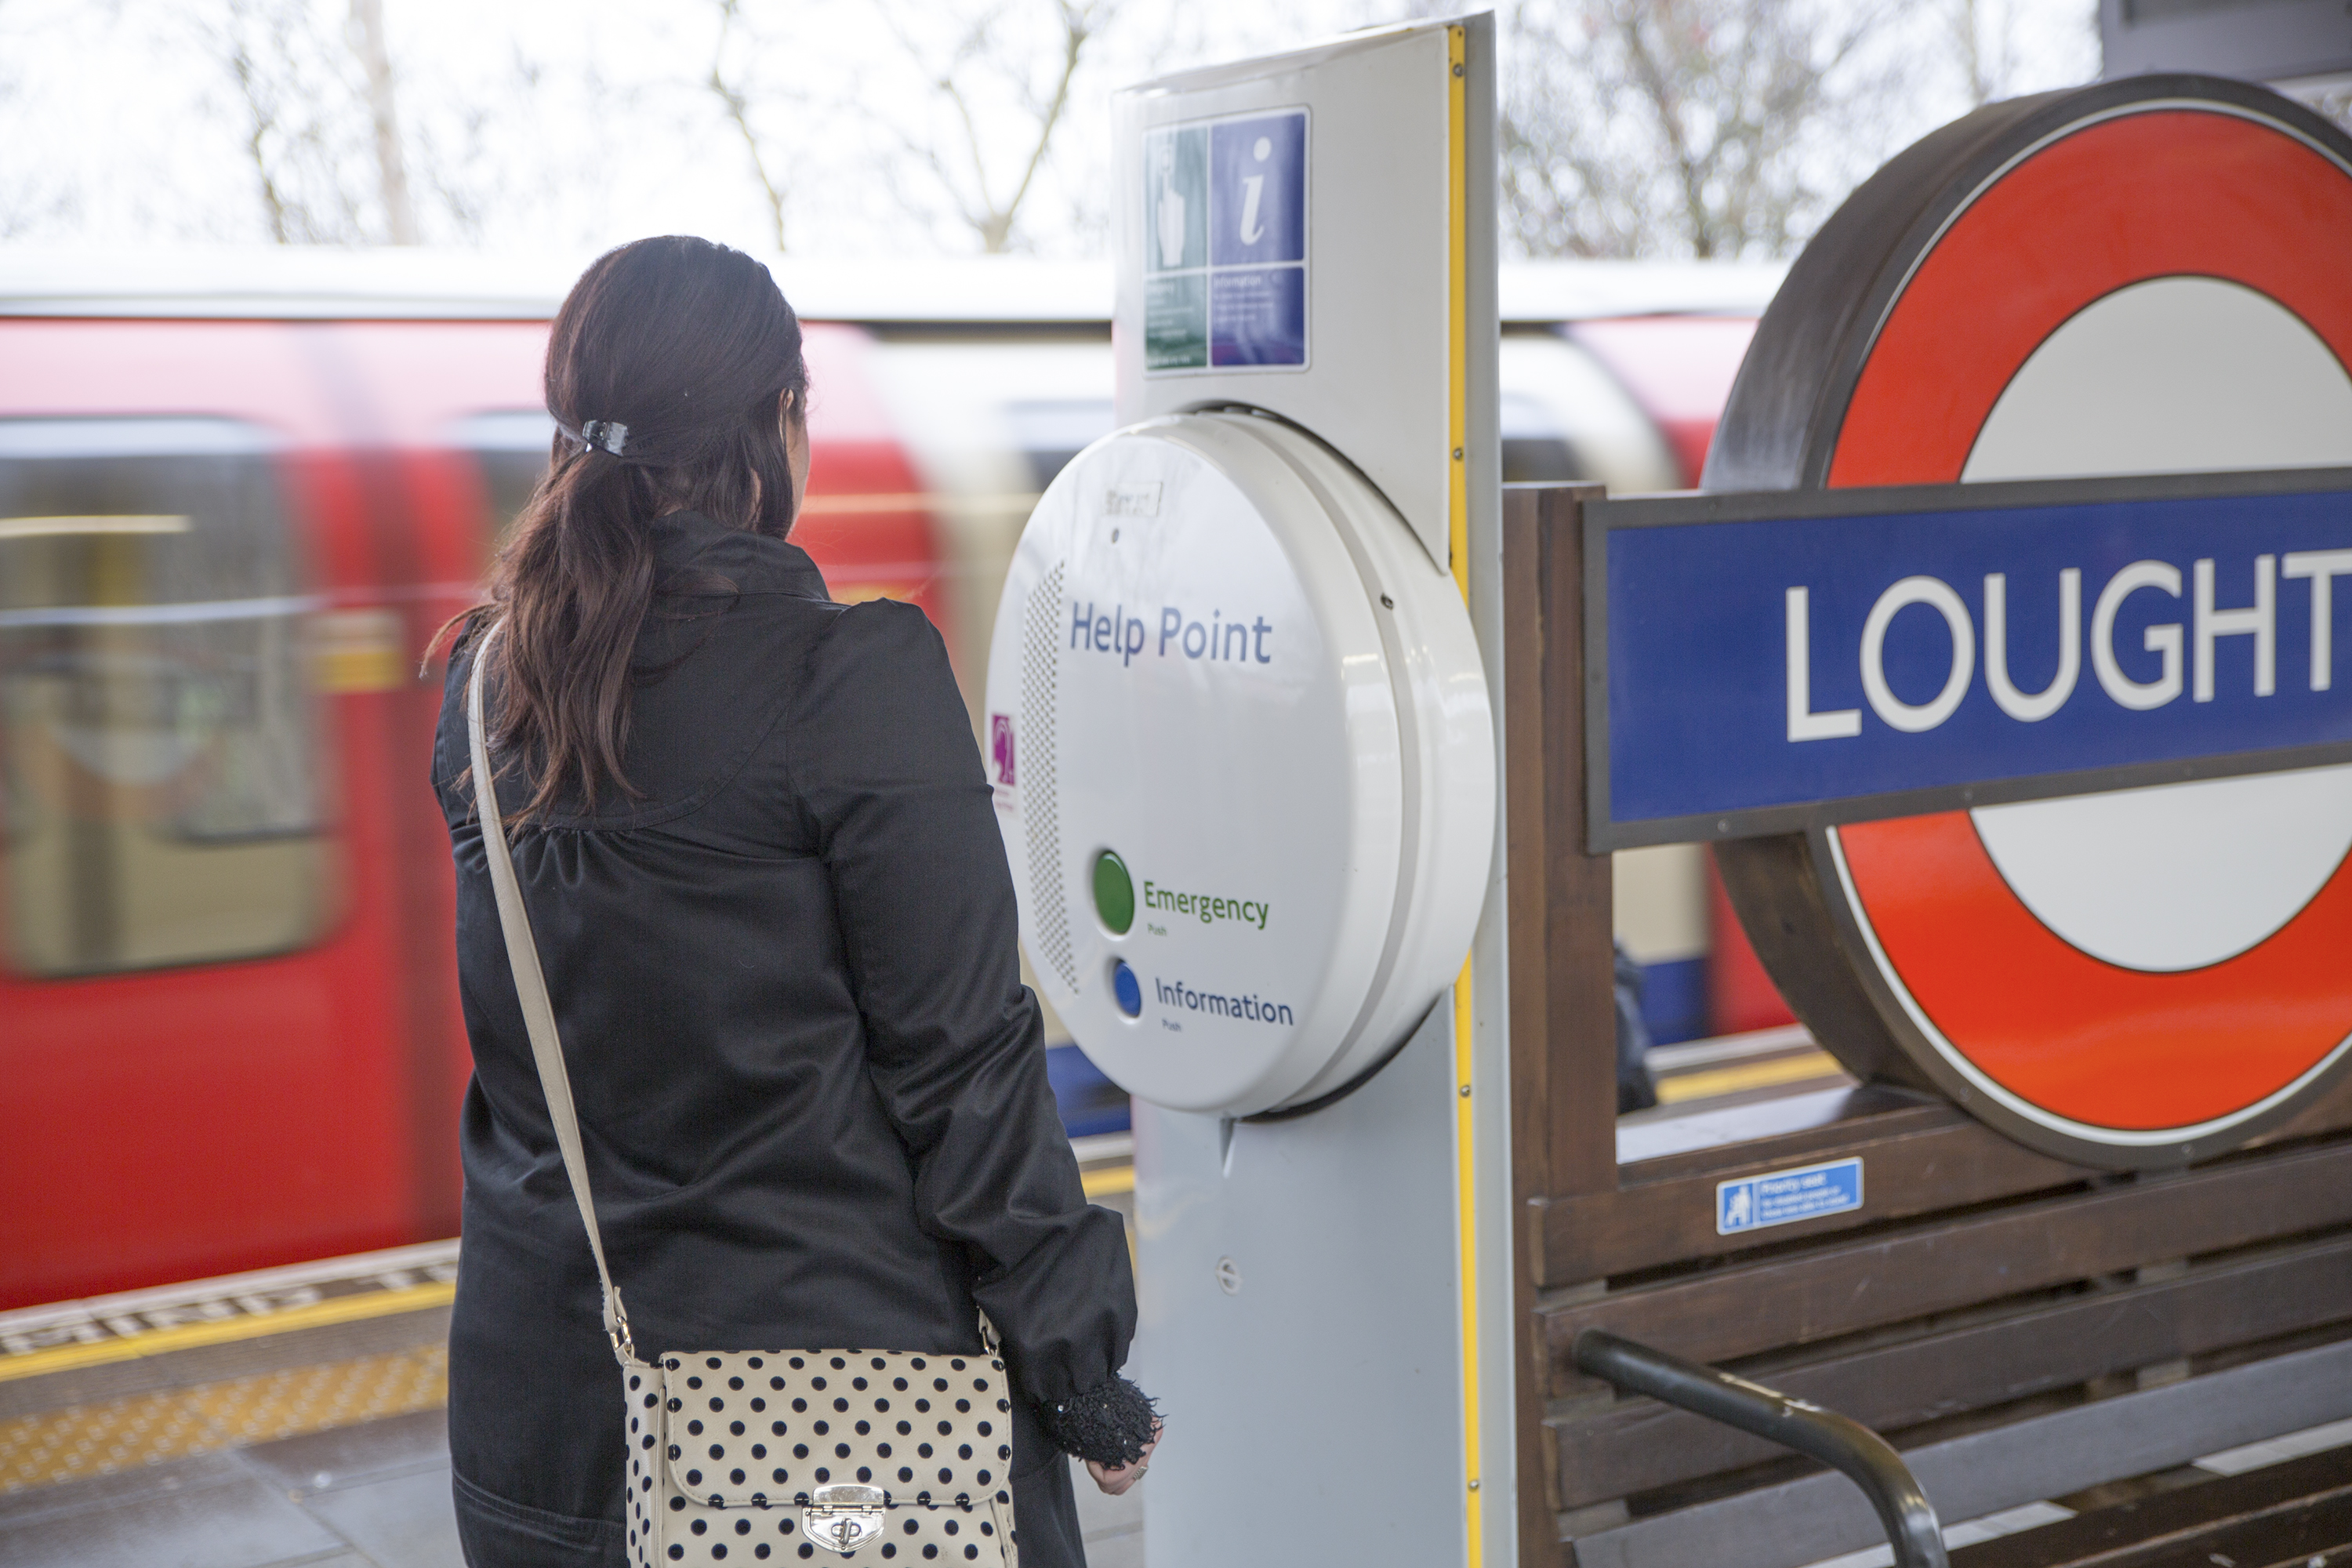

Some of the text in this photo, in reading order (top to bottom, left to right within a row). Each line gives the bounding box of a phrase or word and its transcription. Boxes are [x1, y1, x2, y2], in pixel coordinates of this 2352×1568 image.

[1070, 601, 1272, 667] Help Point
[1785, 548, 2352, 743] LOUGHT
[1144, 880, 1269, 931] Emergency
[1147, 923, 1167, 937] Push
[1155, 978, 1294, 1027] Information
[1162, 1018, 1182, 1033] Push
